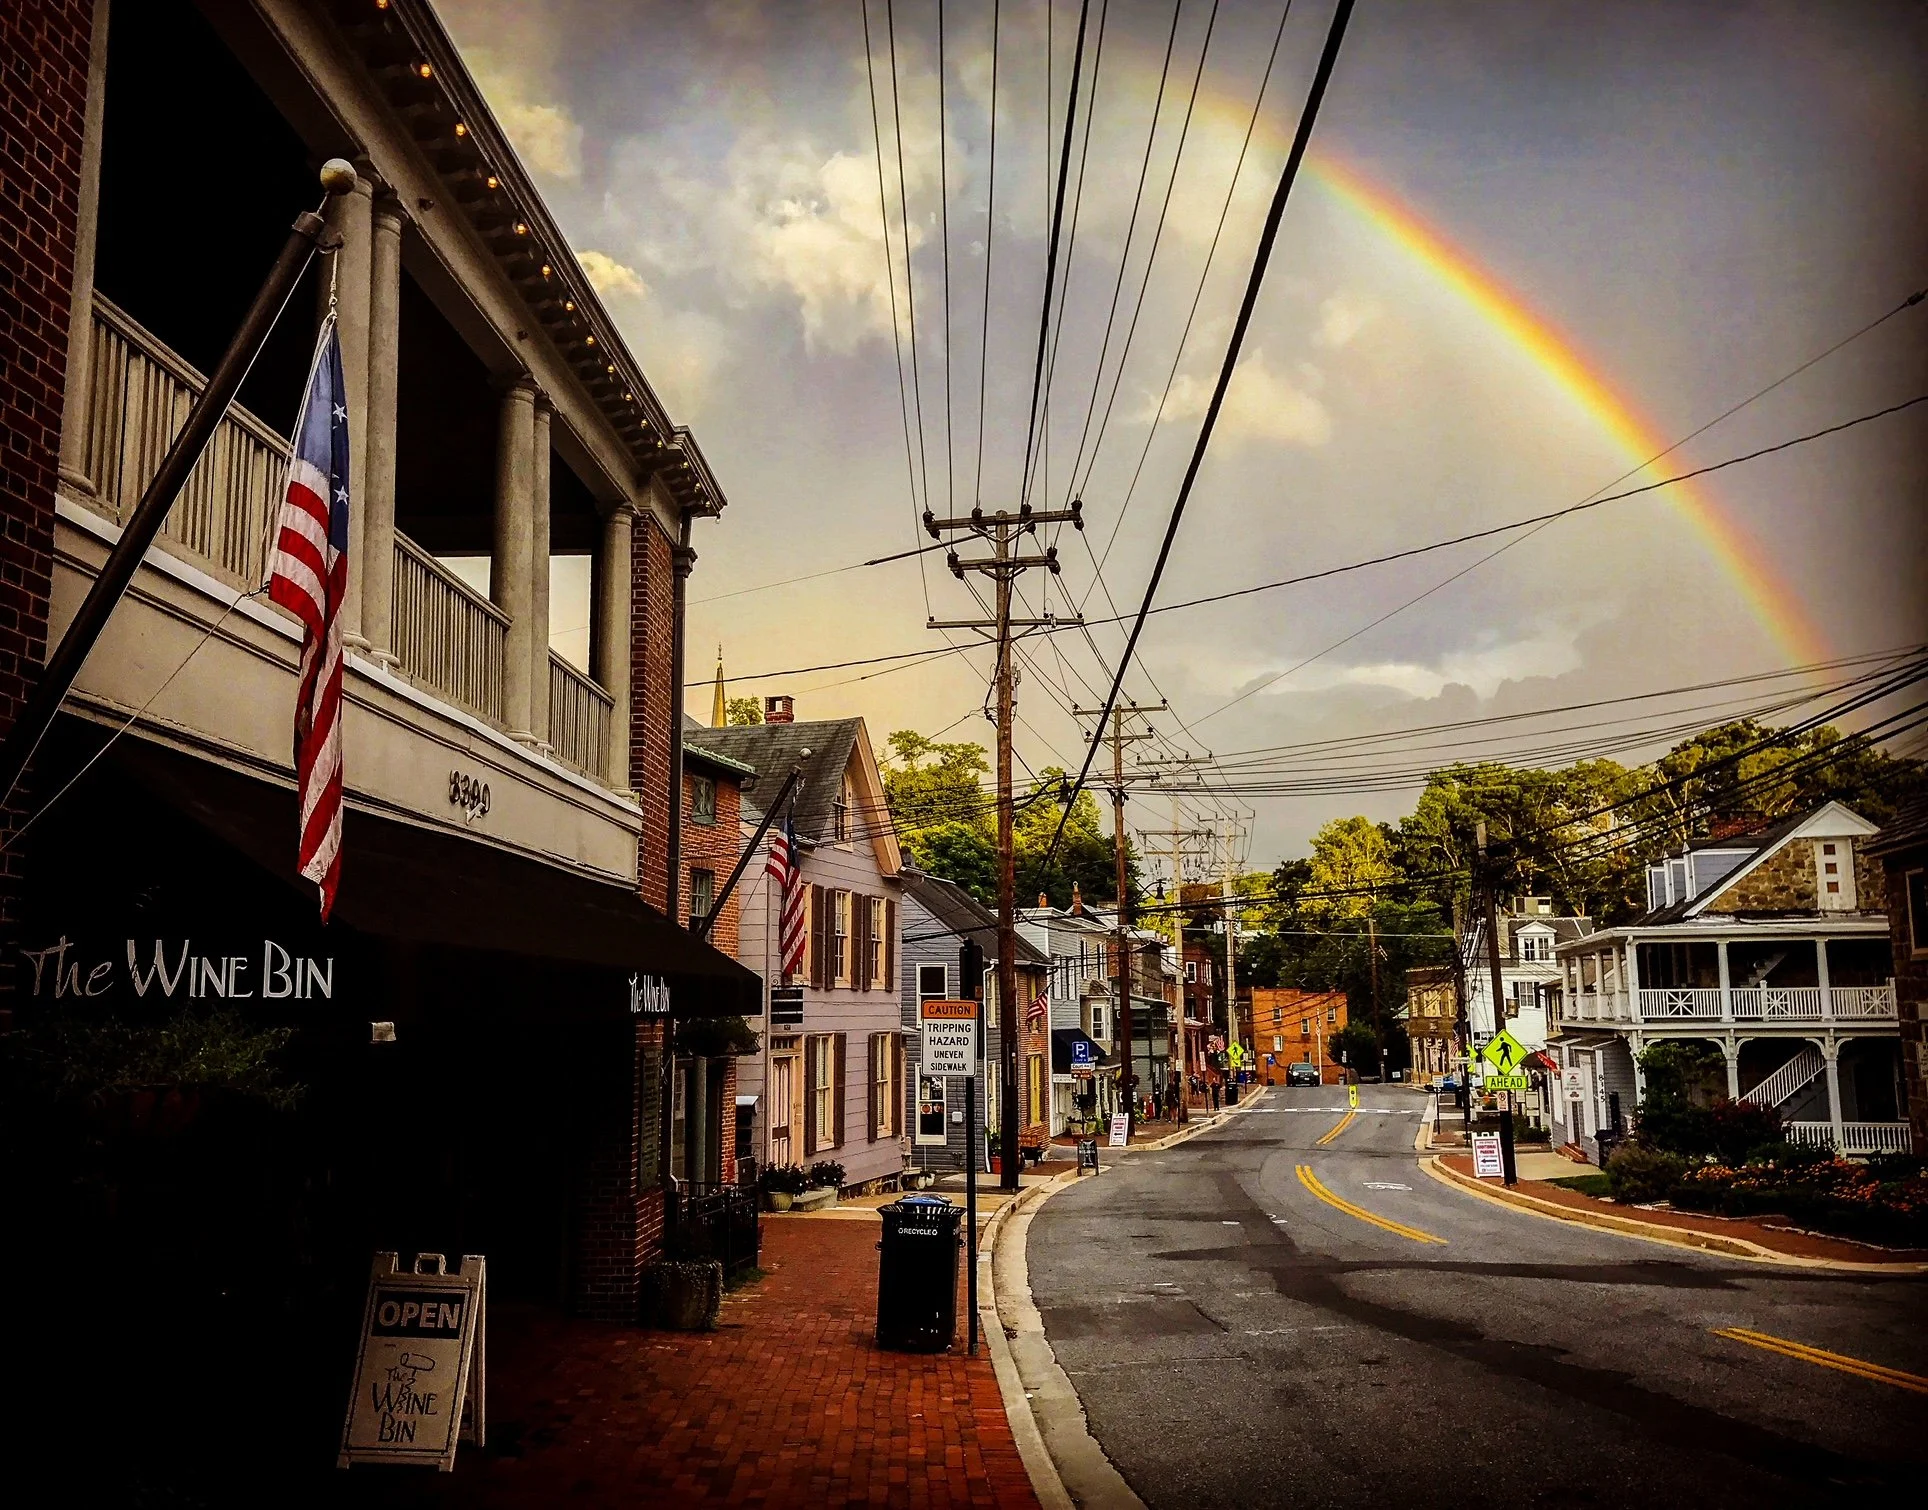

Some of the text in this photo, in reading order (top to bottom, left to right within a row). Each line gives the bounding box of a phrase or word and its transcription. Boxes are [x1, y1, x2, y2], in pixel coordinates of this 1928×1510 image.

[20, 935, 334, 999] The WINE BIN
[628, 972, 644, 1013] The
[928, 1005, 971, 1015] CAUTION
[927, 1023, 971, 1033] TRIPPING
[929, 1036, 969, 1046] HAZARD
[934, 1050, 964, 1059] UNEVEN
[1075, 1043, 1085, 1056] P
[930, 1062, 967, 1072] SIDEWALK
[1490, 1077, 1523, 1088] AHEAD
[1598, 1074, 1606, 1103] 8145
[903, 1227, 932, 1236] RECYCLE
[378, 1300, 461, 1329] OPEN
[384, 1366, 408, 1383] The
[378, 1411, 417, 1443] BIN
